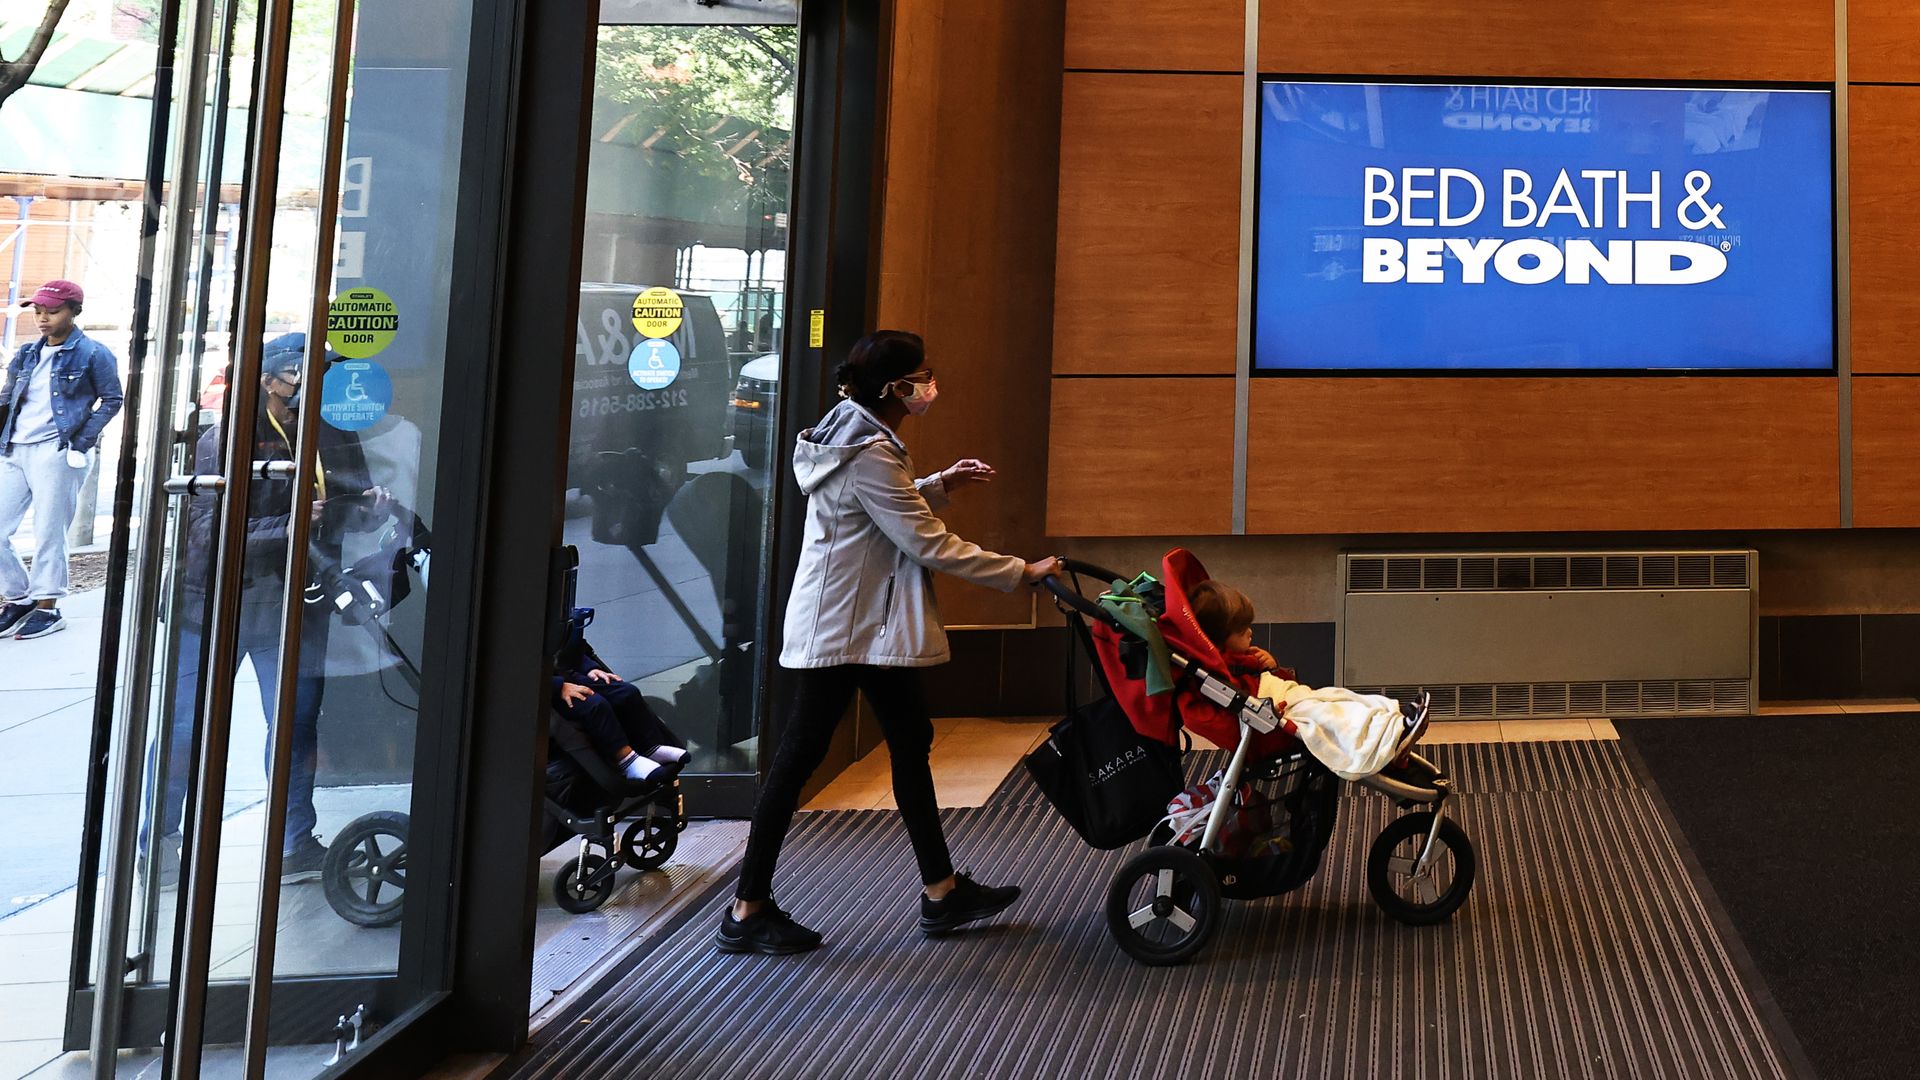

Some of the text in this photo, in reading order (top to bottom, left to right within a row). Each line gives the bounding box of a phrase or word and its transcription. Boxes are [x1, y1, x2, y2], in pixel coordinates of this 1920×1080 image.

[1363, 166, 1727, 230] BED BATH &
[1361, 237, 1729, 285] BEYOND
[329, 302, 392, 312] AUTOMATIC
[635, 308, 681, 318] CAUTION
[328, 317, 395, 330] CAUTION
[646, 320, 668, 328] DOOR
[343, 334, 374, 344] DOOR
[332, 412, 341, 421] TO
[1088, 745, 1145, 782] SAKARA
